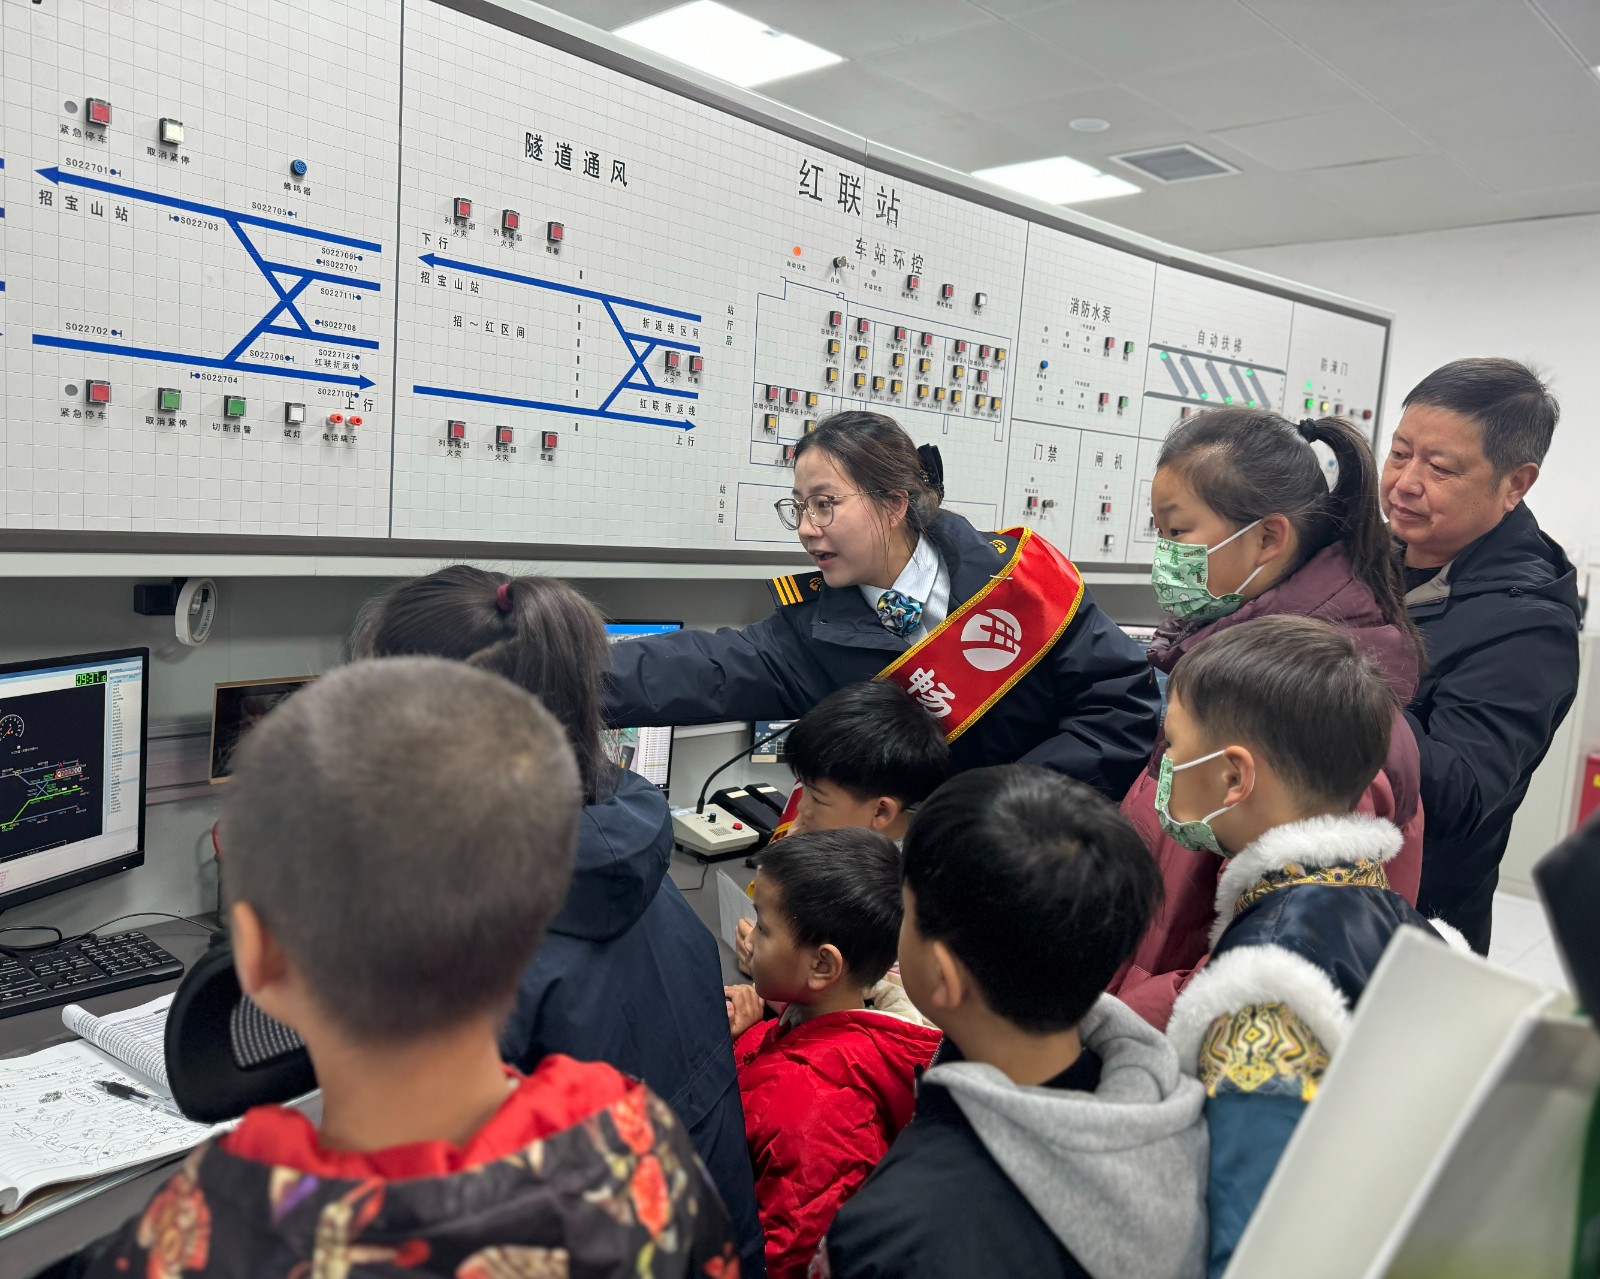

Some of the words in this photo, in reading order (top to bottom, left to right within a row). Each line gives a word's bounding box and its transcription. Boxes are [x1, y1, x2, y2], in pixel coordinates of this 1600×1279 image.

[59, 123, 108, 145] 紧急停车
[146, 146, 191, 166] 取消紧停
[524, 130, 628, 188] 隧道通风
[65, 157, 109, 175] S022701
[798, 159, 901, 229] 红联站
[38, 189, 129, 222] 招宝山站
[251, 201, 288, 217] S022705
[180, 216, 219, 232] S022703
[421, 232, 449, 250] 下行
[452, 228, 468, 238] 火灾
[500, 240, 515, 250] 火灾
[855, 237, 925, 276] 车站环控
[325, 259, 358, 273] S022707
[420, 270, 481, 294] 招宝山站
[320, 287, 354, 300] S022711
[1069, 297, 1112, 324] 消防水泵
[65, 322, 109, 336] S022702
[642, 317, 699, 339] 折返线区间
[725, 304, 735, 346] 站厅层
[318, 348, 352, 360] S022712
[314, 357, 360, 371] 红联折返线
[200, 373, 239, 385] S022704
[344, 397, 374, 413] 上行
[639, 398, 696, 417] 红联折返线
[60, 407, 108, 421] 紧急停车
[145, 415, 188, 429] 取消紧停
[211, 422, 253, 435] 切断报警
[283, 429, 302, 439] 试灯
[675, 434, 695, 447] 上行
[446, 449, 462, 458] 火灾
[494, 454, 509, 462] 火灾
[1033, 443, 1058, 463] 门禁
[906, 667, 956, 718] 畅
